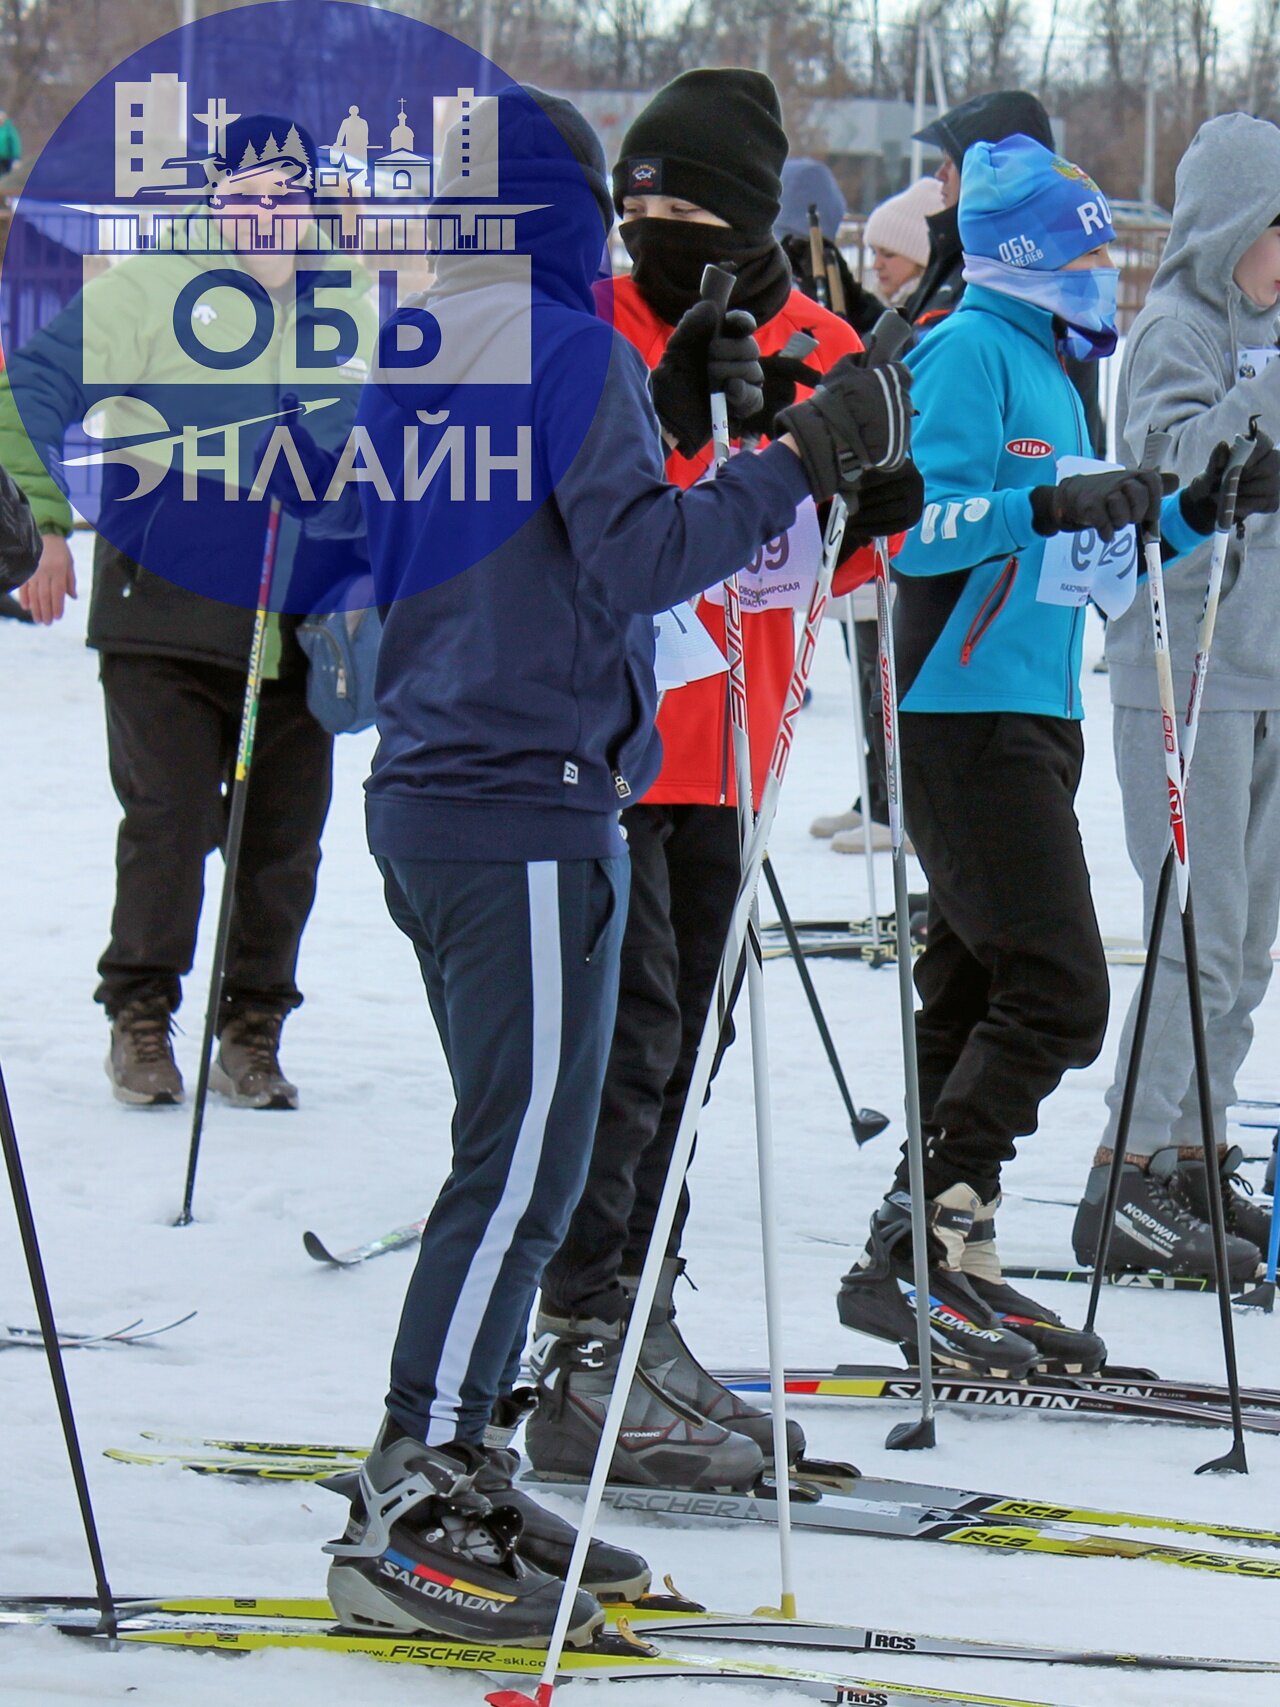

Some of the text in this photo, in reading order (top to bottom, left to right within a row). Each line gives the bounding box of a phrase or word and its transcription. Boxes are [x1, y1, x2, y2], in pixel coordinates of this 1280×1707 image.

[1012, 441, 1047, 456] elips
[879, 653, 893, 743] SPRINT
[1123, 1202, 1181, 1243] NORDWAY
[622, 1430, 661, 1438] ATOMIC
[1001, 1502, 1073, 1519] RCS
[959, 1530, 1033, 1547] RCS
[380, 1560, 507, 1614] SALOMON
[875, 1634, 917, 1651] RCS
